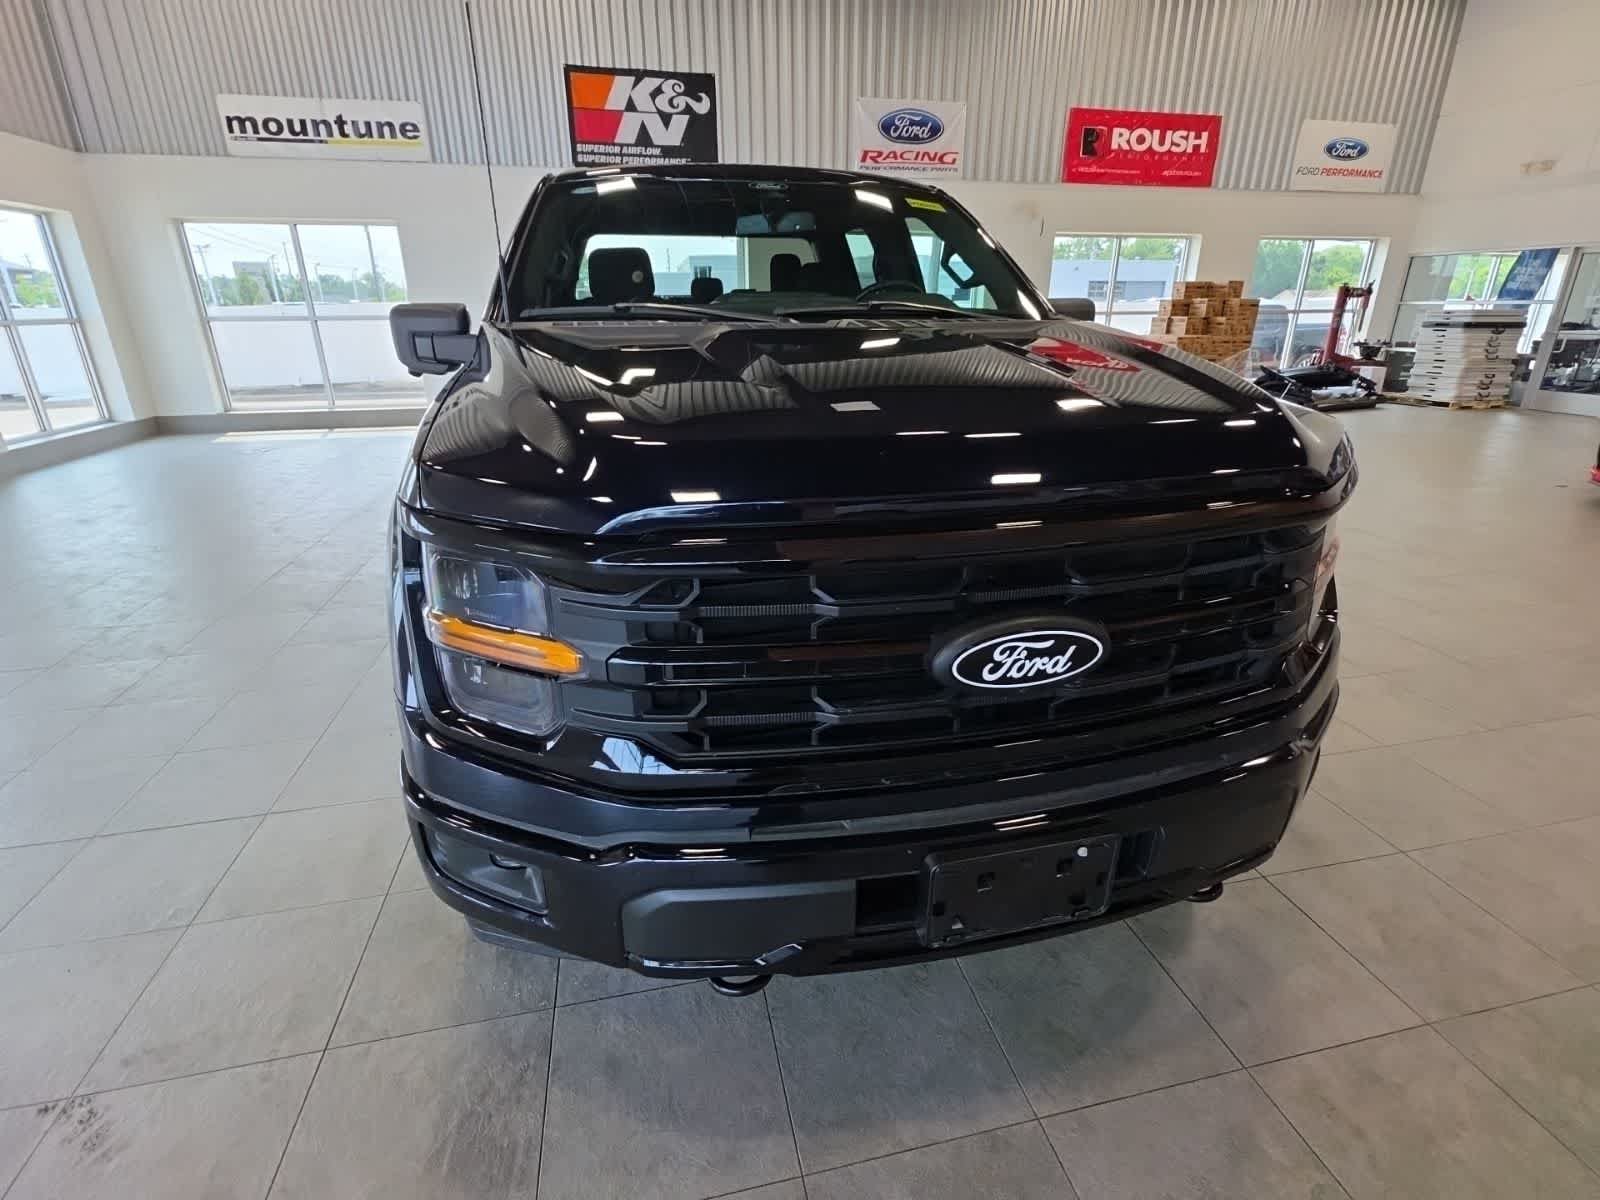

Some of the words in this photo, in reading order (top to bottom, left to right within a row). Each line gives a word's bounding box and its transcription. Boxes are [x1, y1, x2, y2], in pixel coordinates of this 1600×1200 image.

[225, 113, 421, 140] mountune
[890, 113, 932, 138] Ford
[1110, 126, 1209, 153] ROUSH
[577, 143, 621, 154] SUPERIOR
[1331, 141, 1361, 157] Ford
[577, 154, 622, 164] SUPERIOR
[860, 149, 959, 165] RACING
[1296, 166, 1320, 176] FORD
[1319, 167, 1384, 178] PERFORMANCE
[982, 639, 1077, 682] Ford
